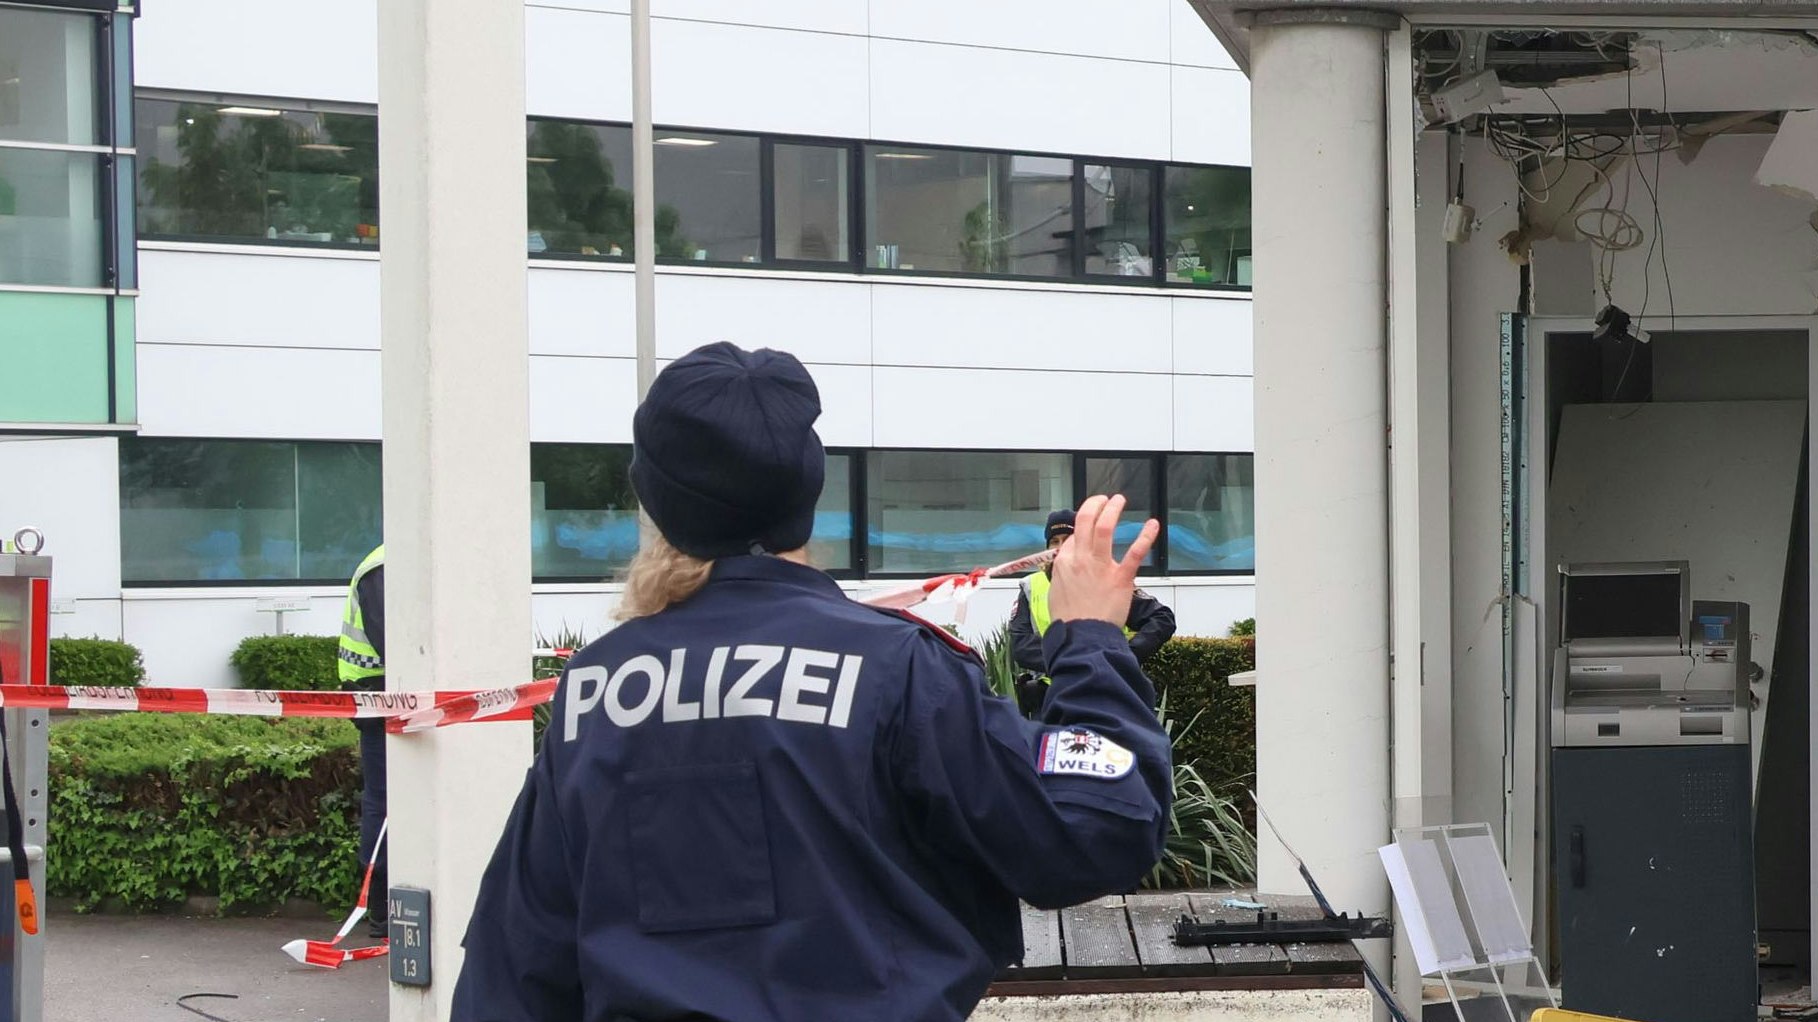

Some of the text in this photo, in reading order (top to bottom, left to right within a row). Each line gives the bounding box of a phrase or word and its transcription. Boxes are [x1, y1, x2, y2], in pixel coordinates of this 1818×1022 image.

[563, 644, 863, 743] POLIZEI
[1059, 759, 1117, 775] WELS
[389, 898, 402, 919] AV
